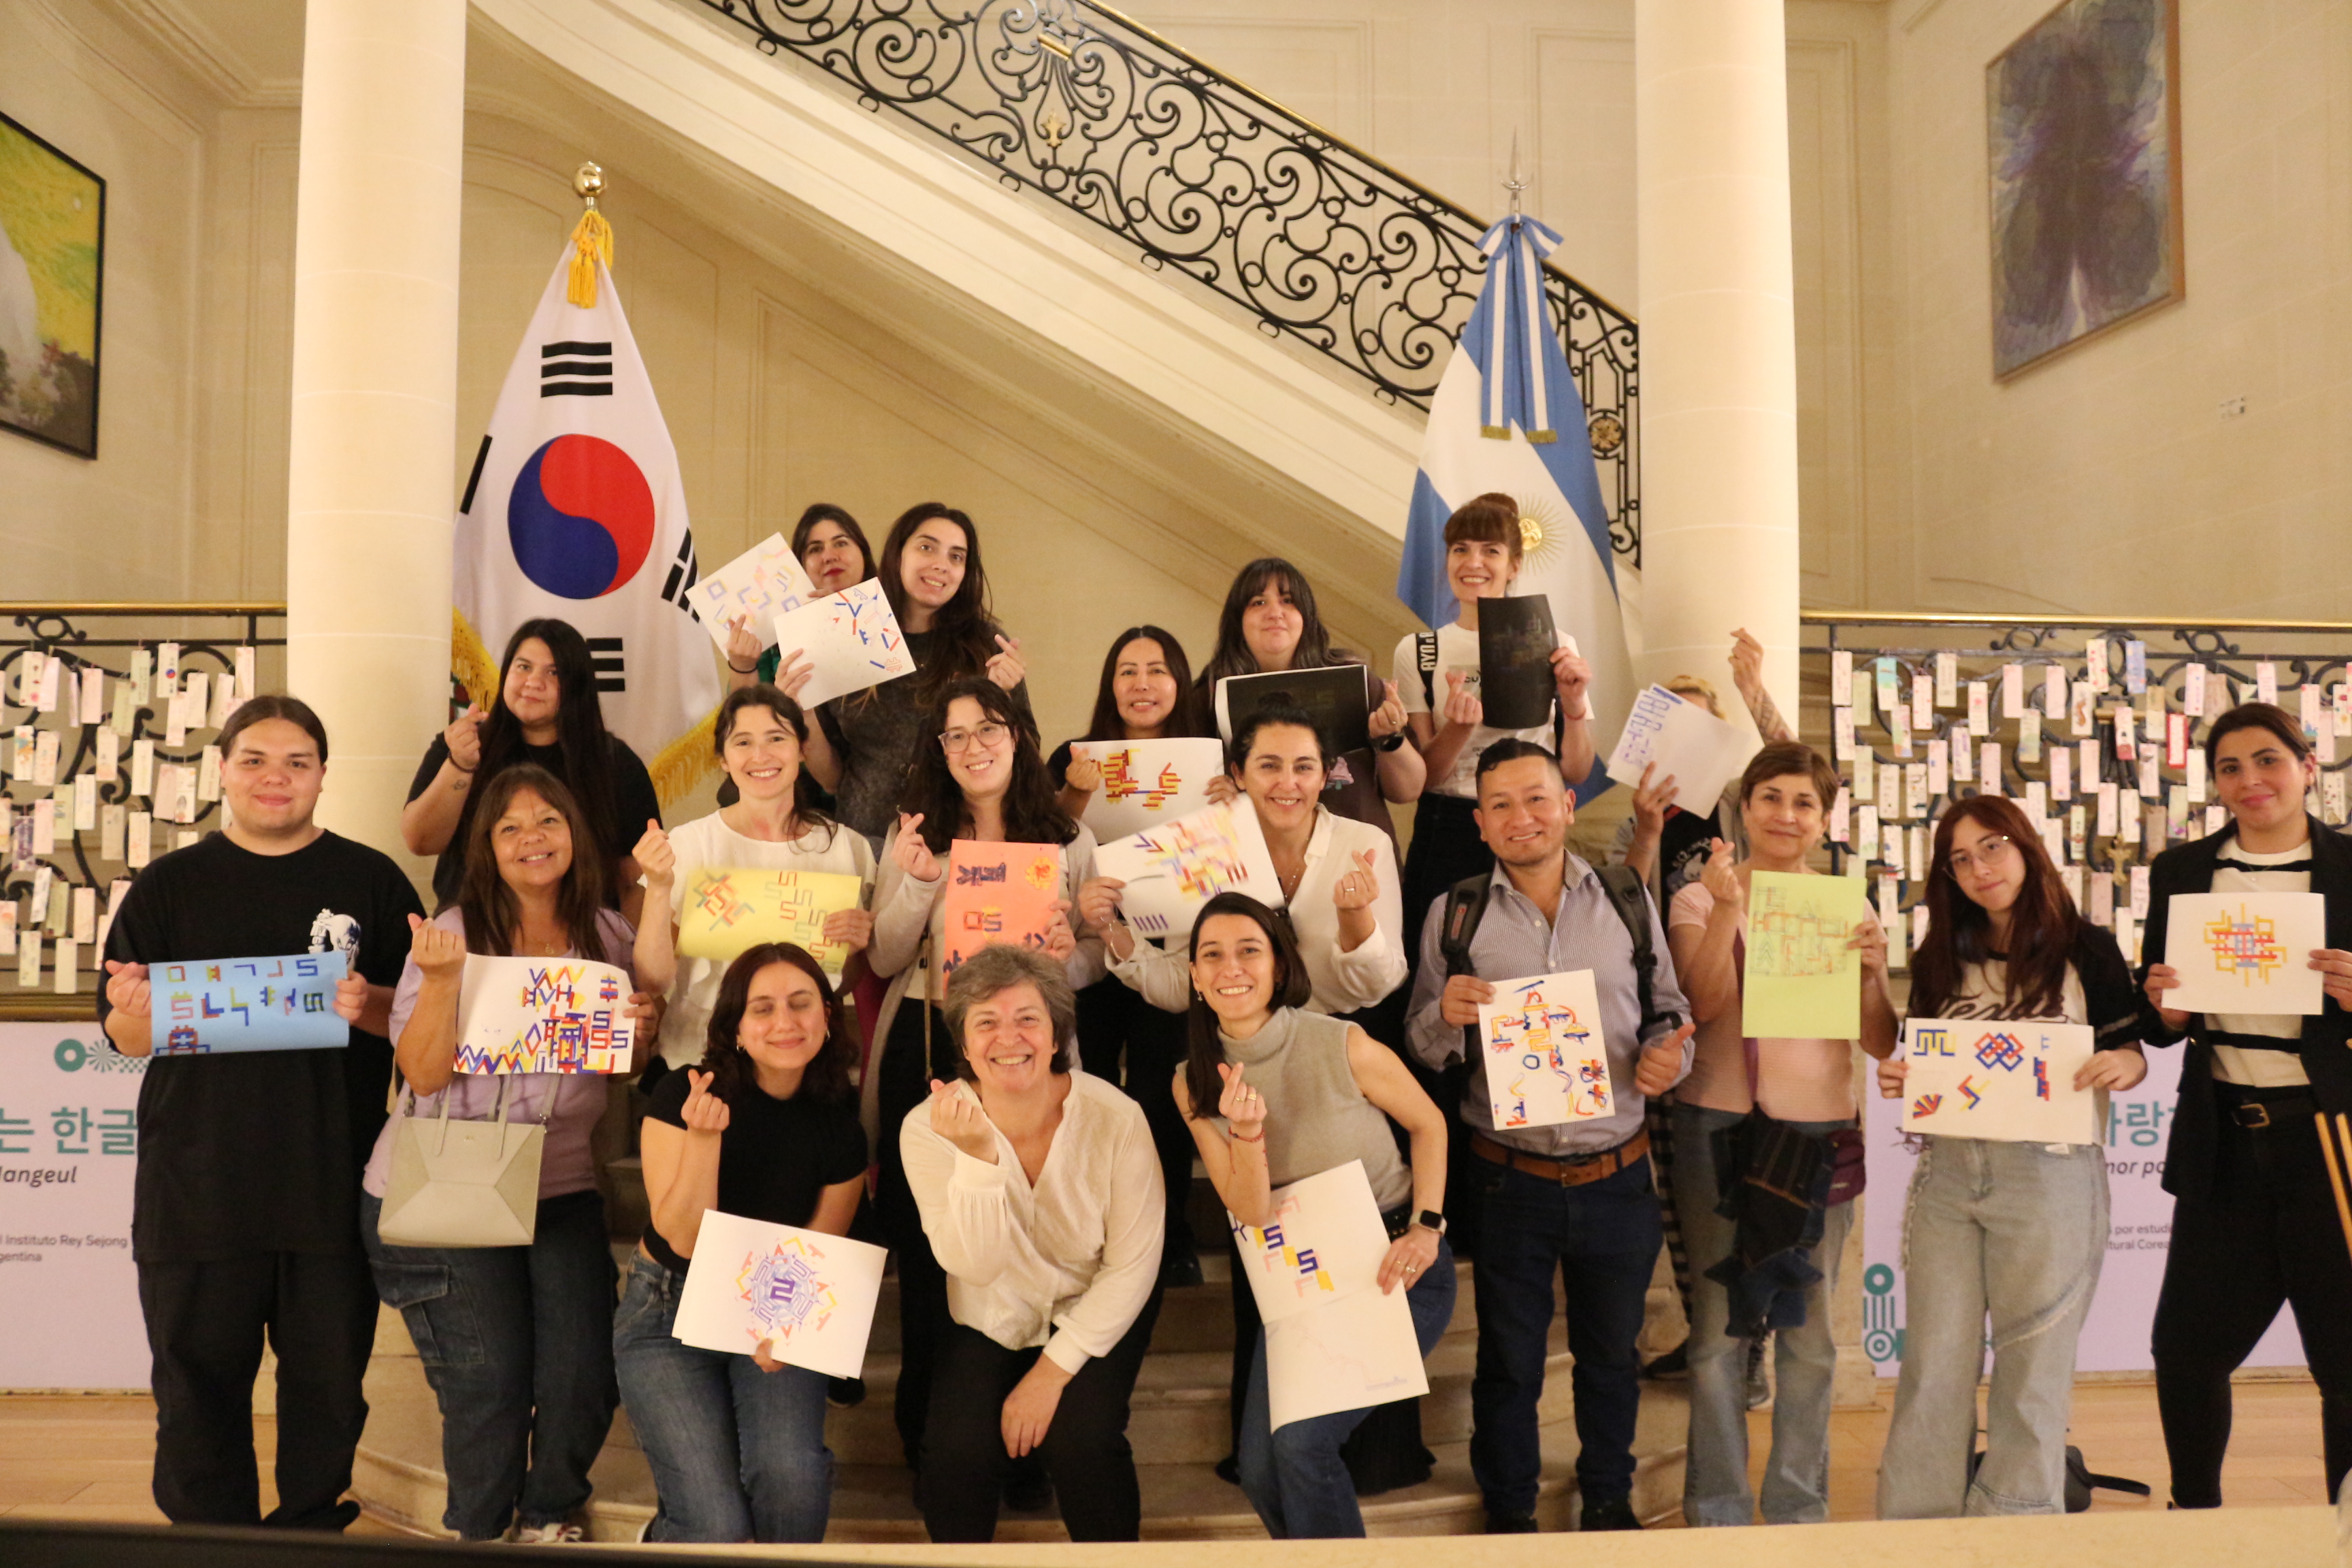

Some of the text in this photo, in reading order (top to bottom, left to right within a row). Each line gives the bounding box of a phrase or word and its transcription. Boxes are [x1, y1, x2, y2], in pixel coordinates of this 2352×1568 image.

[51, 1107, 137, 1154] 한글
[5, 1235, 56, 1245] Instituto
[60, 1235, 82, 1247] Rey
[86, 1235, 127, 1248] Sejong
